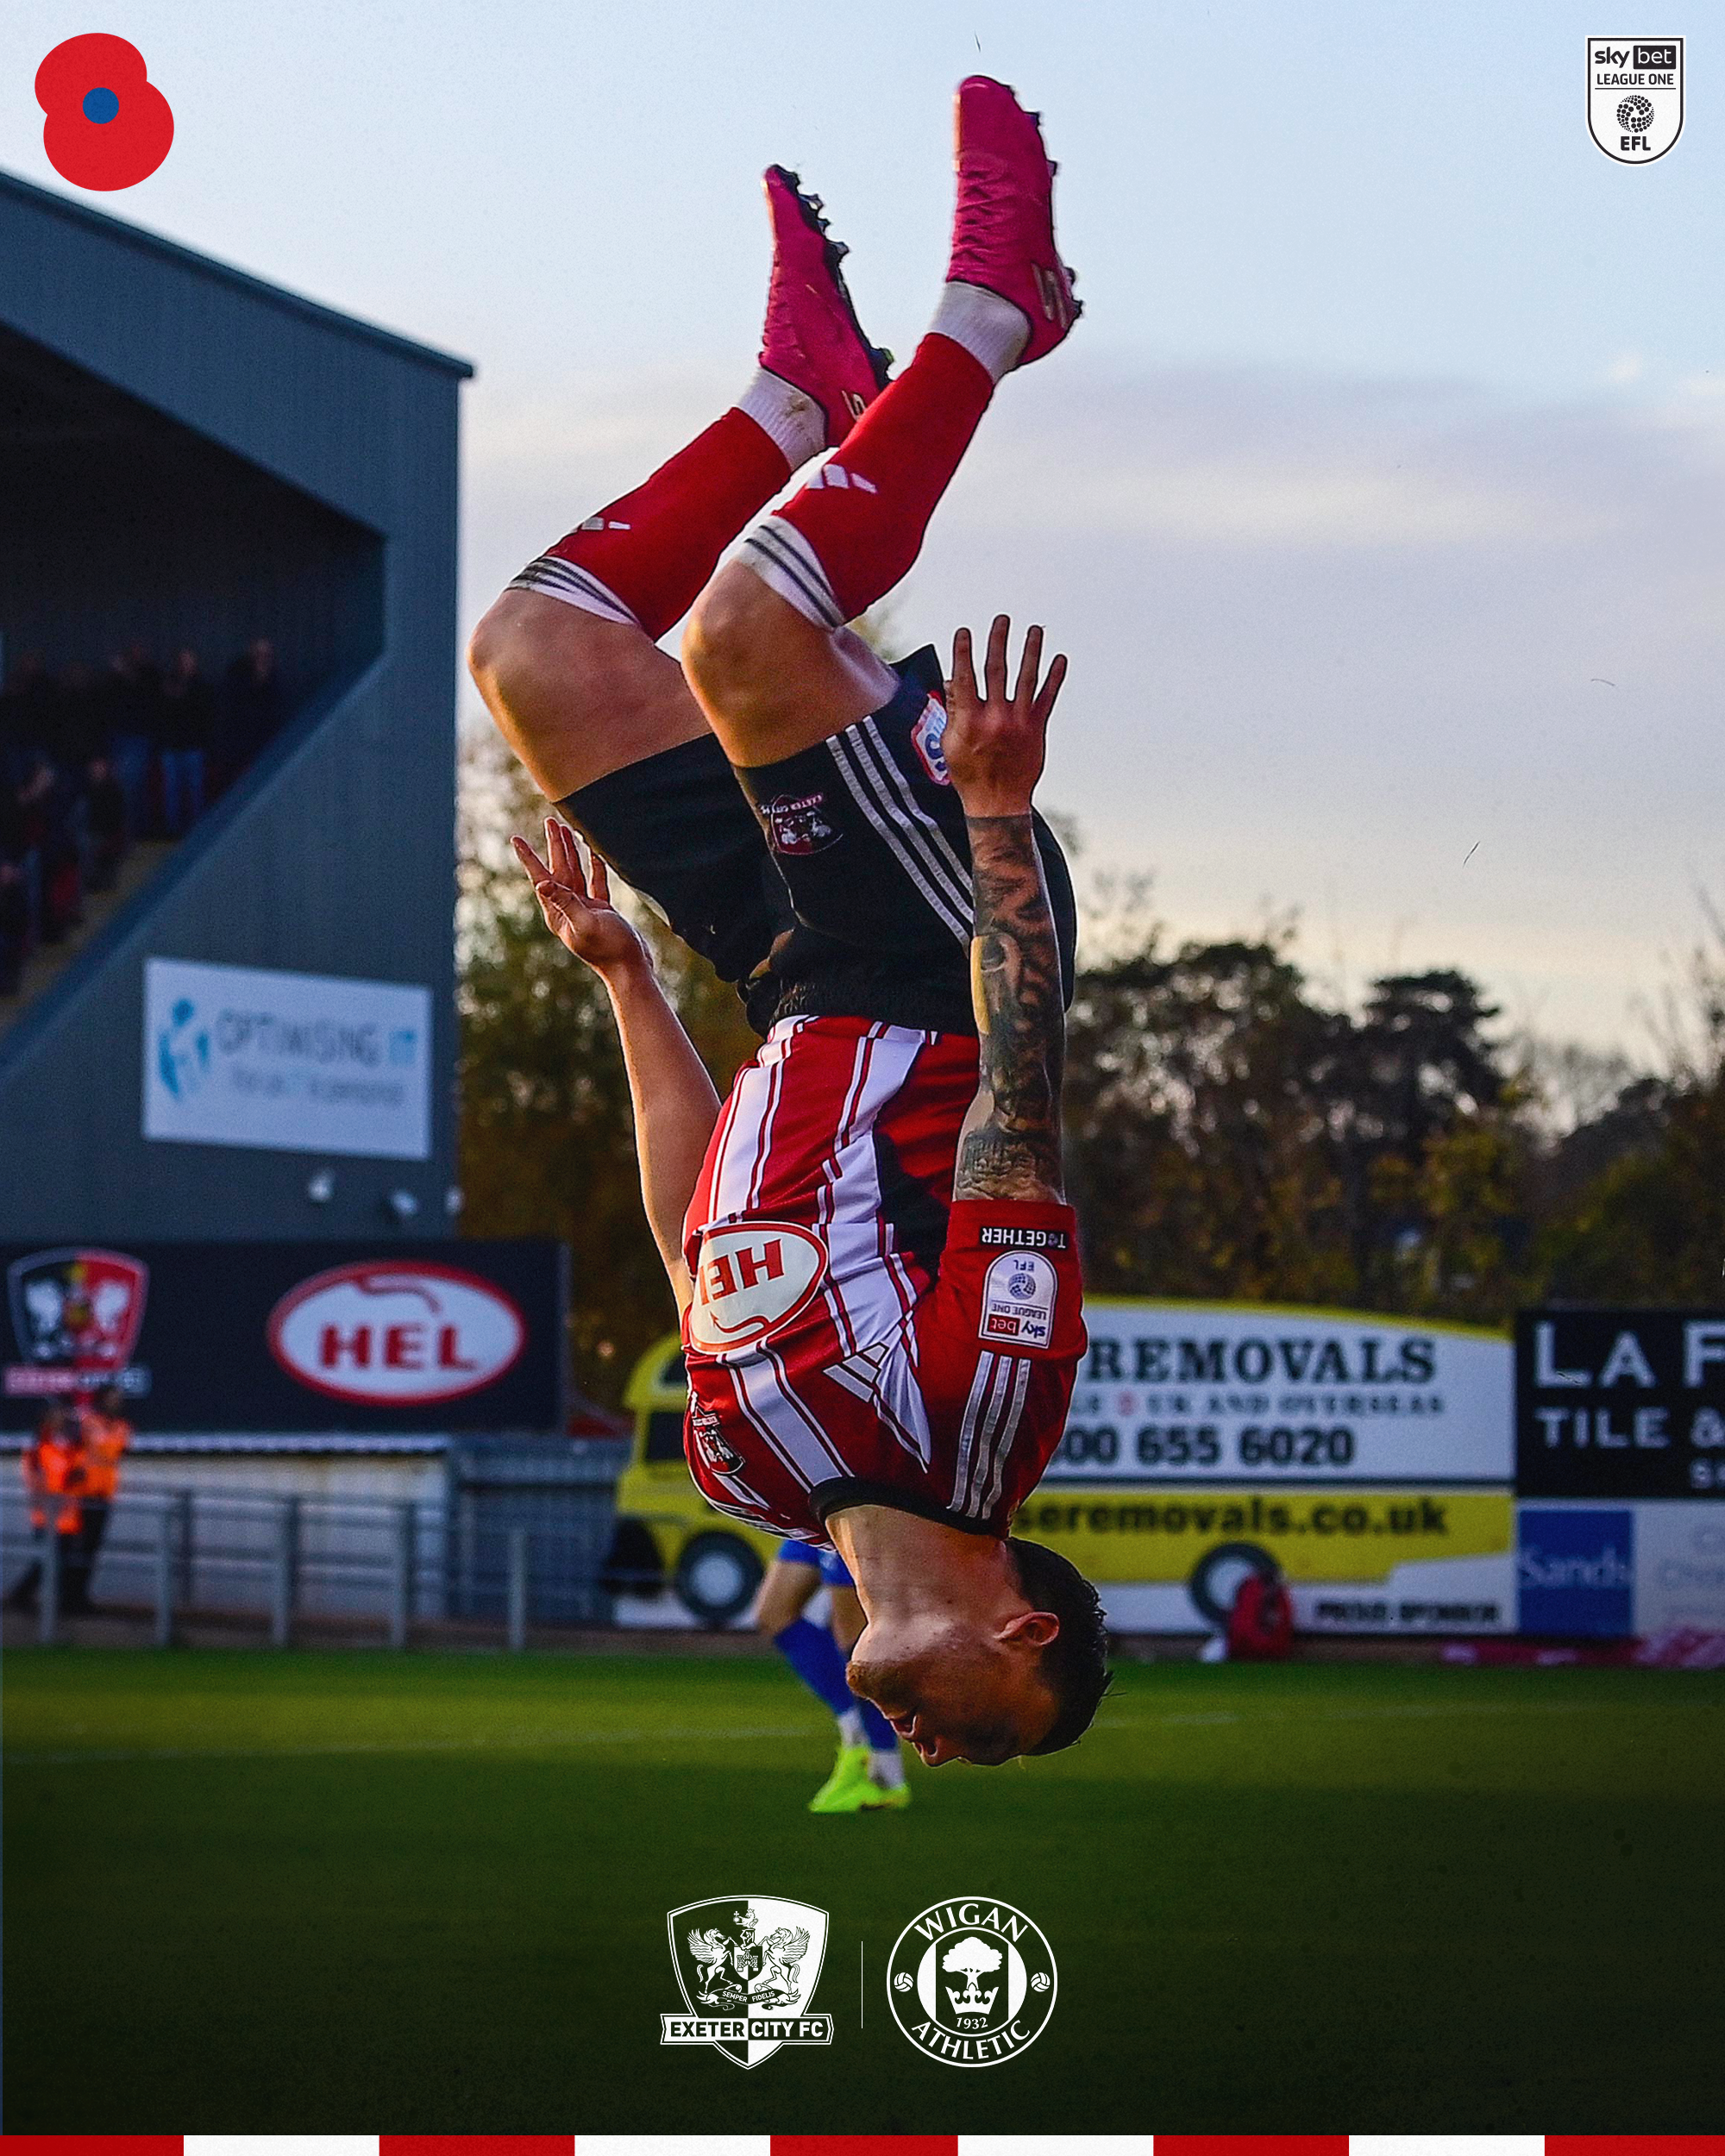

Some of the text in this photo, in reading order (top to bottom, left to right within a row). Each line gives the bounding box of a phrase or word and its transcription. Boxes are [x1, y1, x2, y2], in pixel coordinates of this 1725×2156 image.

[1013, 1260, 1035, 1272] EFL
[991, 1303, 1046, 1320] LEAGUE ONE
[991, 1318, 1046, 1338] sky bet
[320, 1324, 477, 1369] HEL
[1088, 1338, 1437, 1384] REMOVALS
[1534, 1320, 1658, 1388] LA
[1206, 1391, 1270, 1416] AND
[1276, 1391, 1445, 1417] OVERSEAS
[1134, 1425, 1222, 1467] 655
[1237, 1425, 1356, 1468] 6020
[1534, 1406, 1672, 1449] TILE
